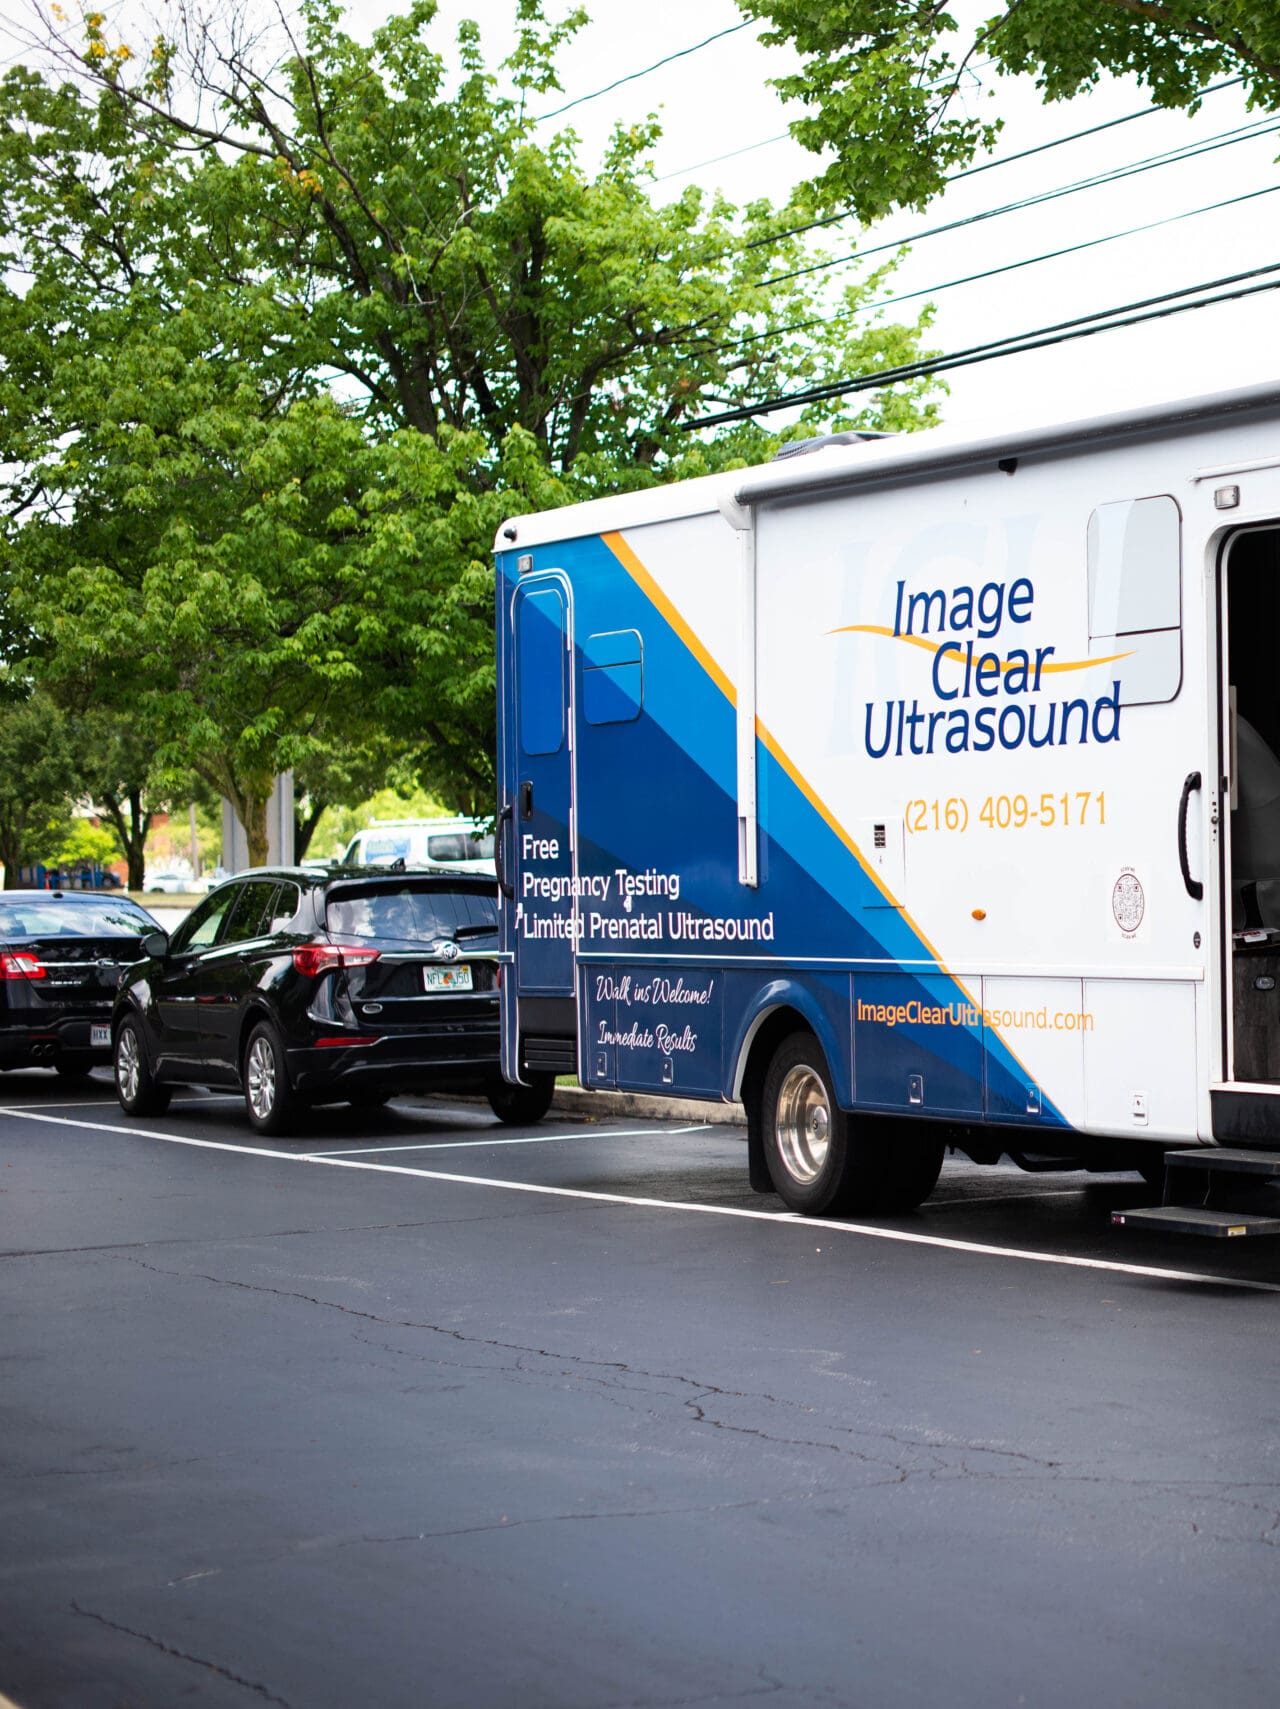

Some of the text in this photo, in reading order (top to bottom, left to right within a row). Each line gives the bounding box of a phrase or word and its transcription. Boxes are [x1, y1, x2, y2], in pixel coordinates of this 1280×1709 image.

[893, 577, 1035, 639] Image
[932, 640, 1056, 701] Clear
[865, 680, 1122, 759] Ultrasound
[905, 791, 1106, 834] (216) 409-5171
[523, 834, 559, 860] Free
[523, 868, 680, 902] Pregnancy Testing
[523, 912, 775, 941] Limited Prenatal Ultrasound
[597, 975, 714, 1006] Walk ins Welcome!
[857, 998, 1094, 1032] ImageClearUltrasound.com
[597, 1020, 698, 1055] Immediate Results
